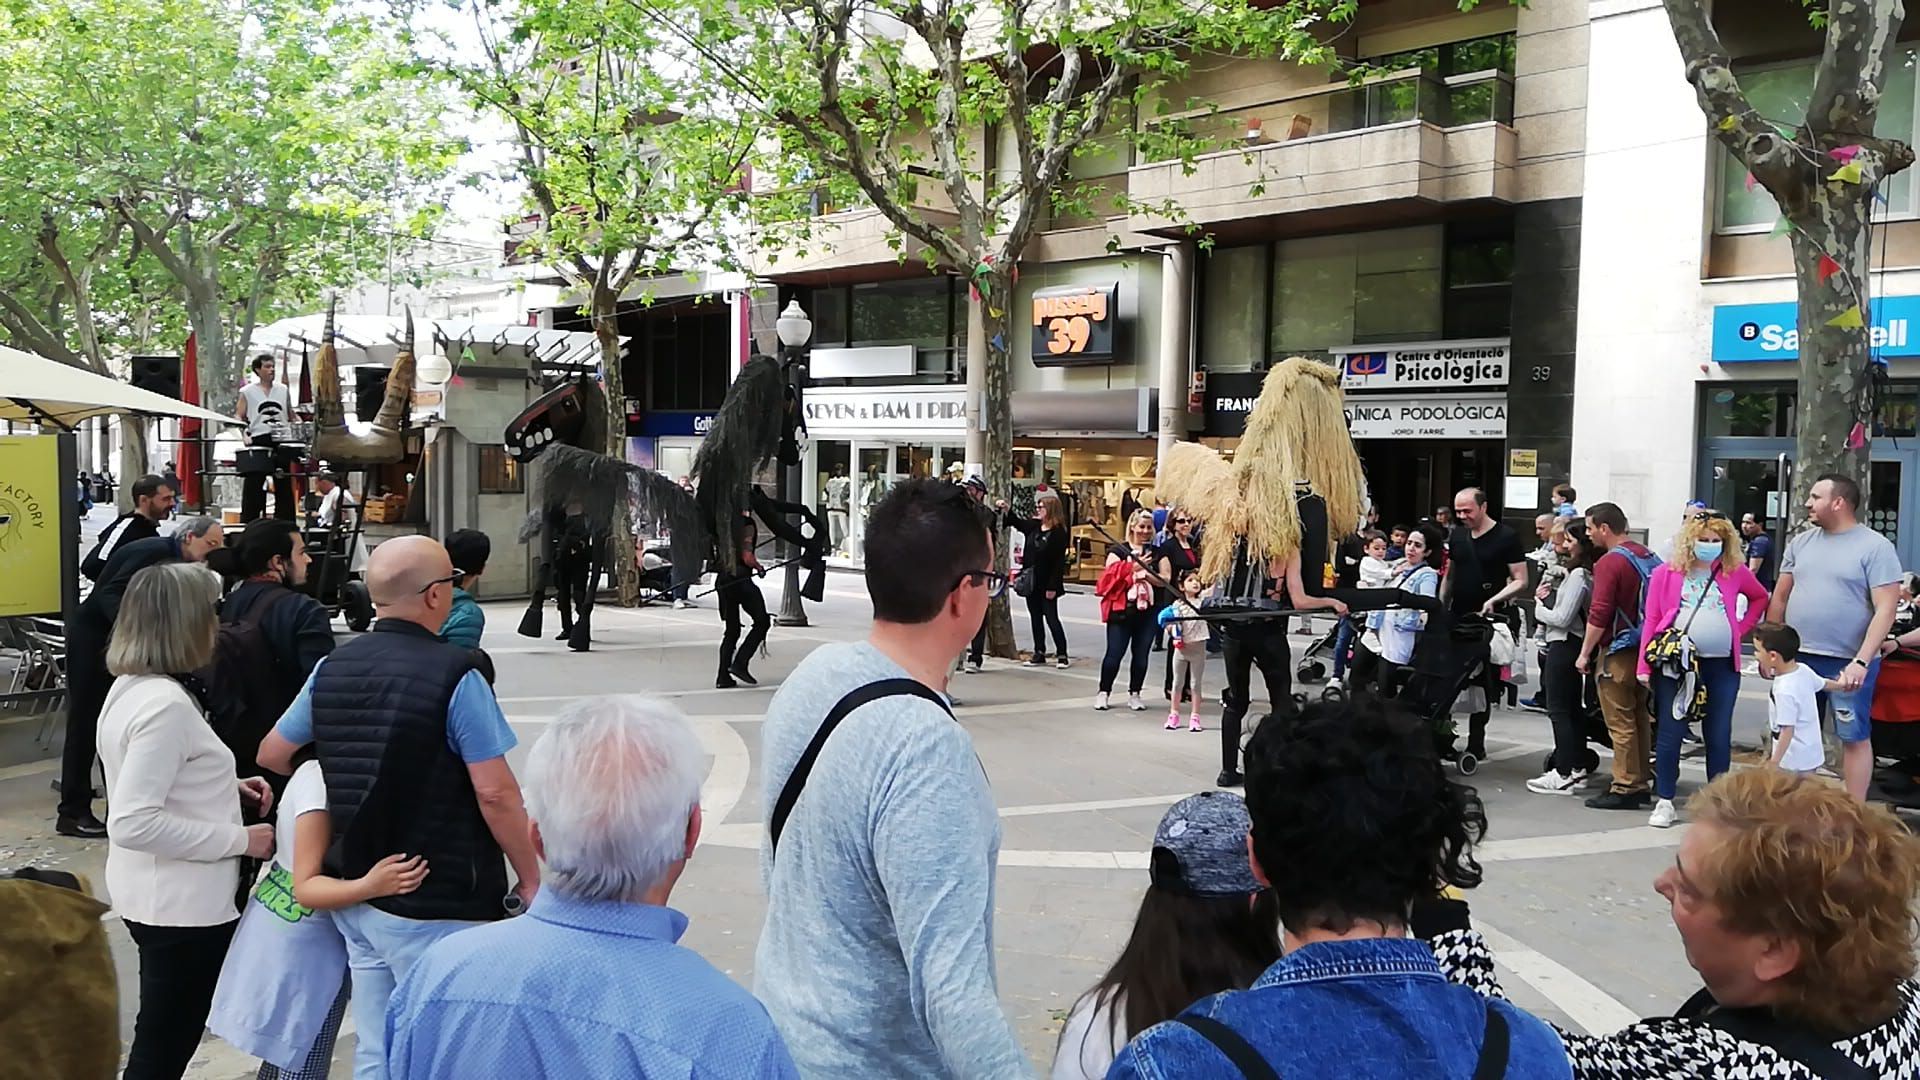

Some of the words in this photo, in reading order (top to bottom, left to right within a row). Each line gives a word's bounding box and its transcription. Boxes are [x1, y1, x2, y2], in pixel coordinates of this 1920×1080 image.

[1048, 316, 1090, 354] 39
[1760, 319, 1907, 351] Saell
[1395, 350, 1430, 362] Centre
[1433, 347, 1504, 361] d'Orientació
[1395, 359, 1504, 384] Psicològica
[1532, 366, 1551, 381] 39
[806, 403, 856, 419] SEVEN
[860, 408, 868, 418] &
[872, 402, 911, 419] PAM
[1400, 402, 1506, 421] PODOLÒGICA
[0, 482, 44, 529] ACTORY
